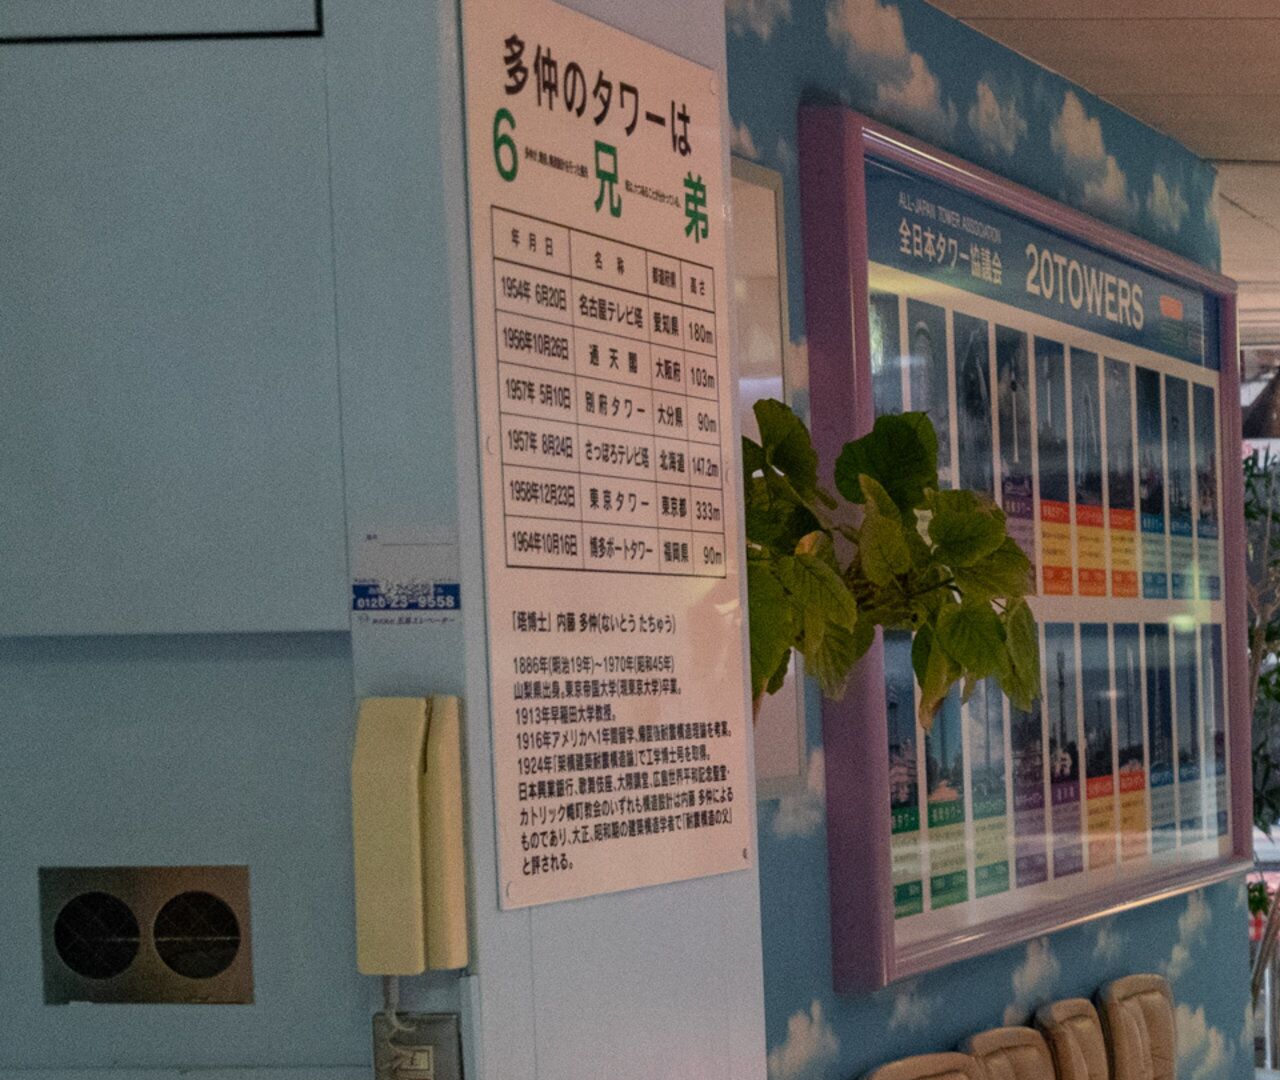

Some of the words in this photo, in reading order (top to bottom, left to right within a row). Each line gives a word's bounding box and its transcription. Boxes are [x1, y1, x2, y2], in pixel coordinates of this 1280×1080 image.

[503, 34, 692, 157] 多仲のタワーは
[493, 107, 519, 183] 6
[594, 139, 622, 218] 兄
[683, 171, 710, 243] 弟
[899, 217, 1002, 286] 全日本タワー協議会
[1025, 242, 1144, 331] 20TOWERS
[579, 294, 644, 329] 名古屋テレビ塔
[653, 311, 679, 337] 愛知県
[689, 321, 714, 345] 180m
[655, 358, 681, 383] 大阪府
[690, 366, 715, 389] 103m
[584, 391, 645, 419] 別府タワー
[657, 404, 683, 428] 大分県
[697, 412, 717, 433] 90m
[585, 441, 650, 468] さっぽろテレビ塔
[660, 449, 685, 474] 北海道
[589, 488, 650, 513] 東京タワー
[661, 496, 687, 518] 東京都
[696, 501, 721, 522] 333m
[589, 536, 653, 560] 博多ポートタワー
[663, 541, 689, 563] 福岡県
[703, 546, 722, 565] 90m
